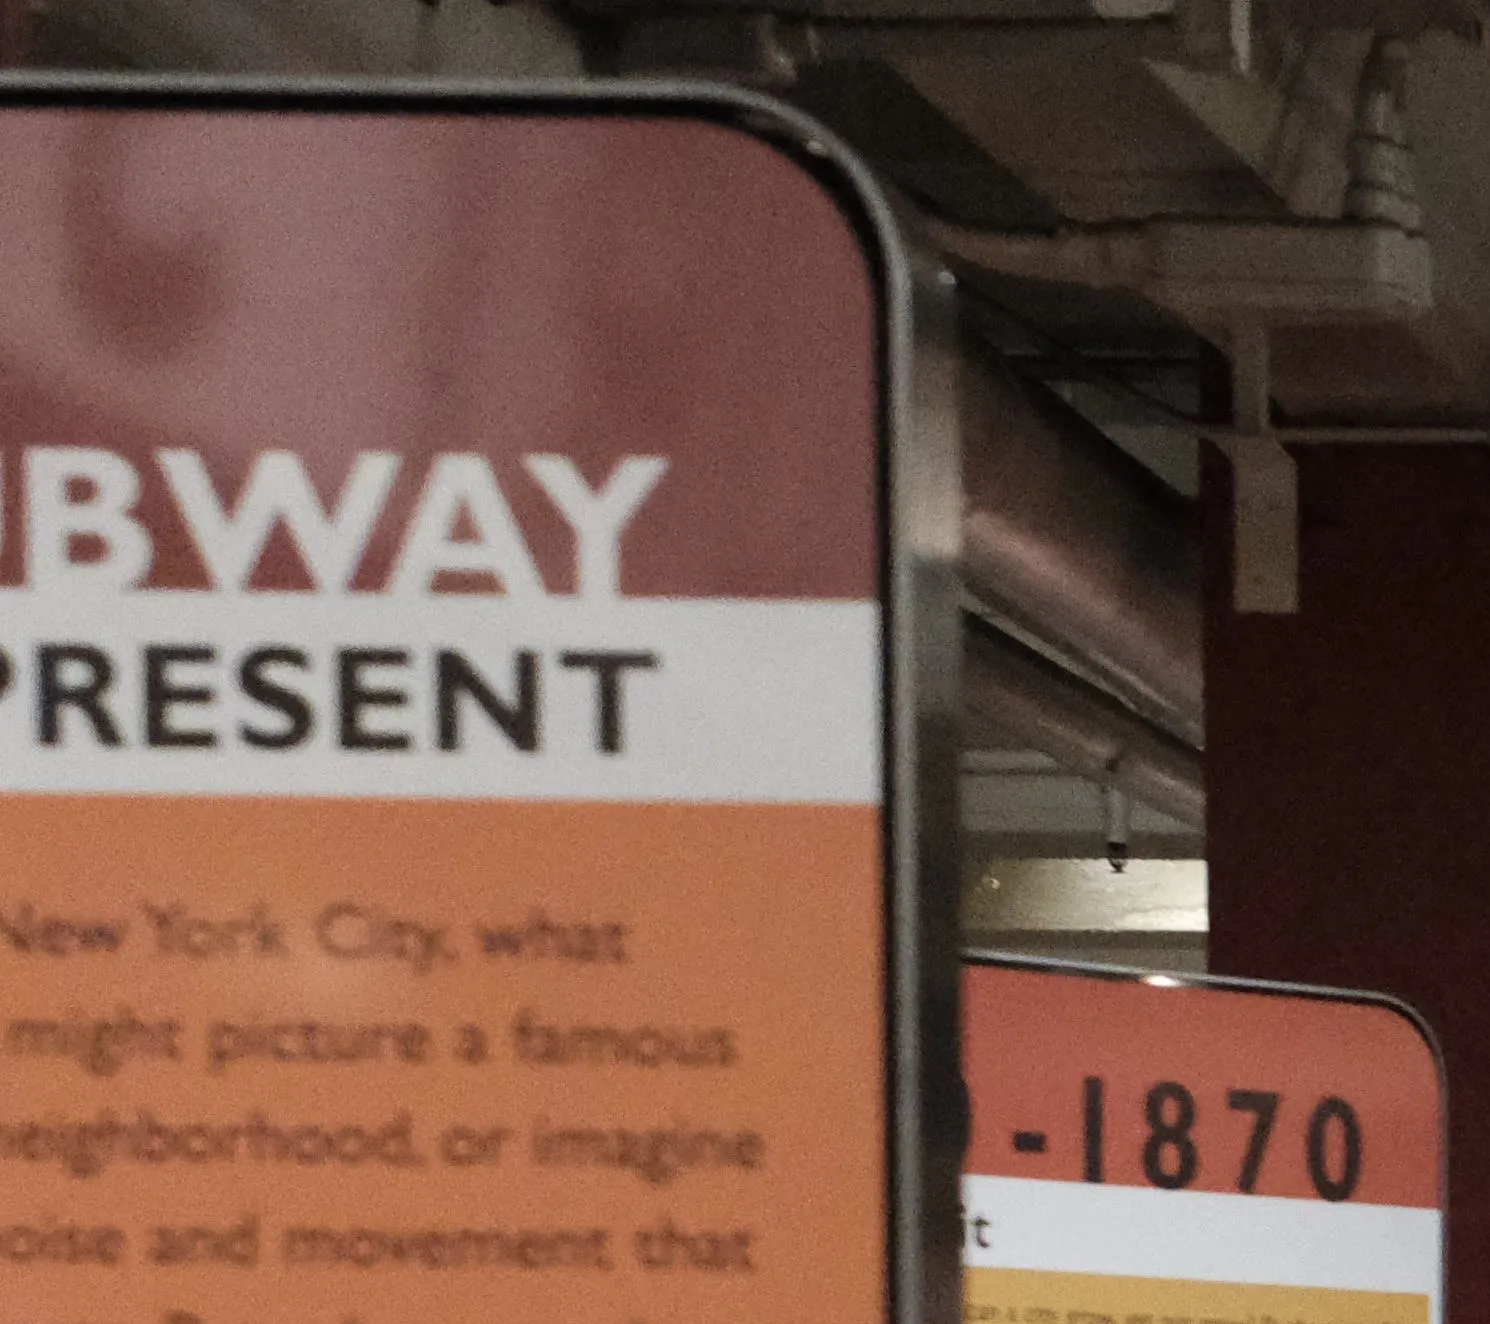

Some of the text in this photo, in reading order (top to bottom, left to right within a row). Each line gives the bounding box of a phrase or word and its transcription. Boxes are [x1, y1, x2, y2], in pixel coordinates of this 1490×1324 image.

[0, 445, 670, 597] BWAY
[0, 642, 660, 756] RESENT
[453, 1023, 491, 1066] a
[0, 1111, 428, 1180] eighborhood,
[147, 1213, 260, 1269] and
[633, 1216, 758, 1275] that
